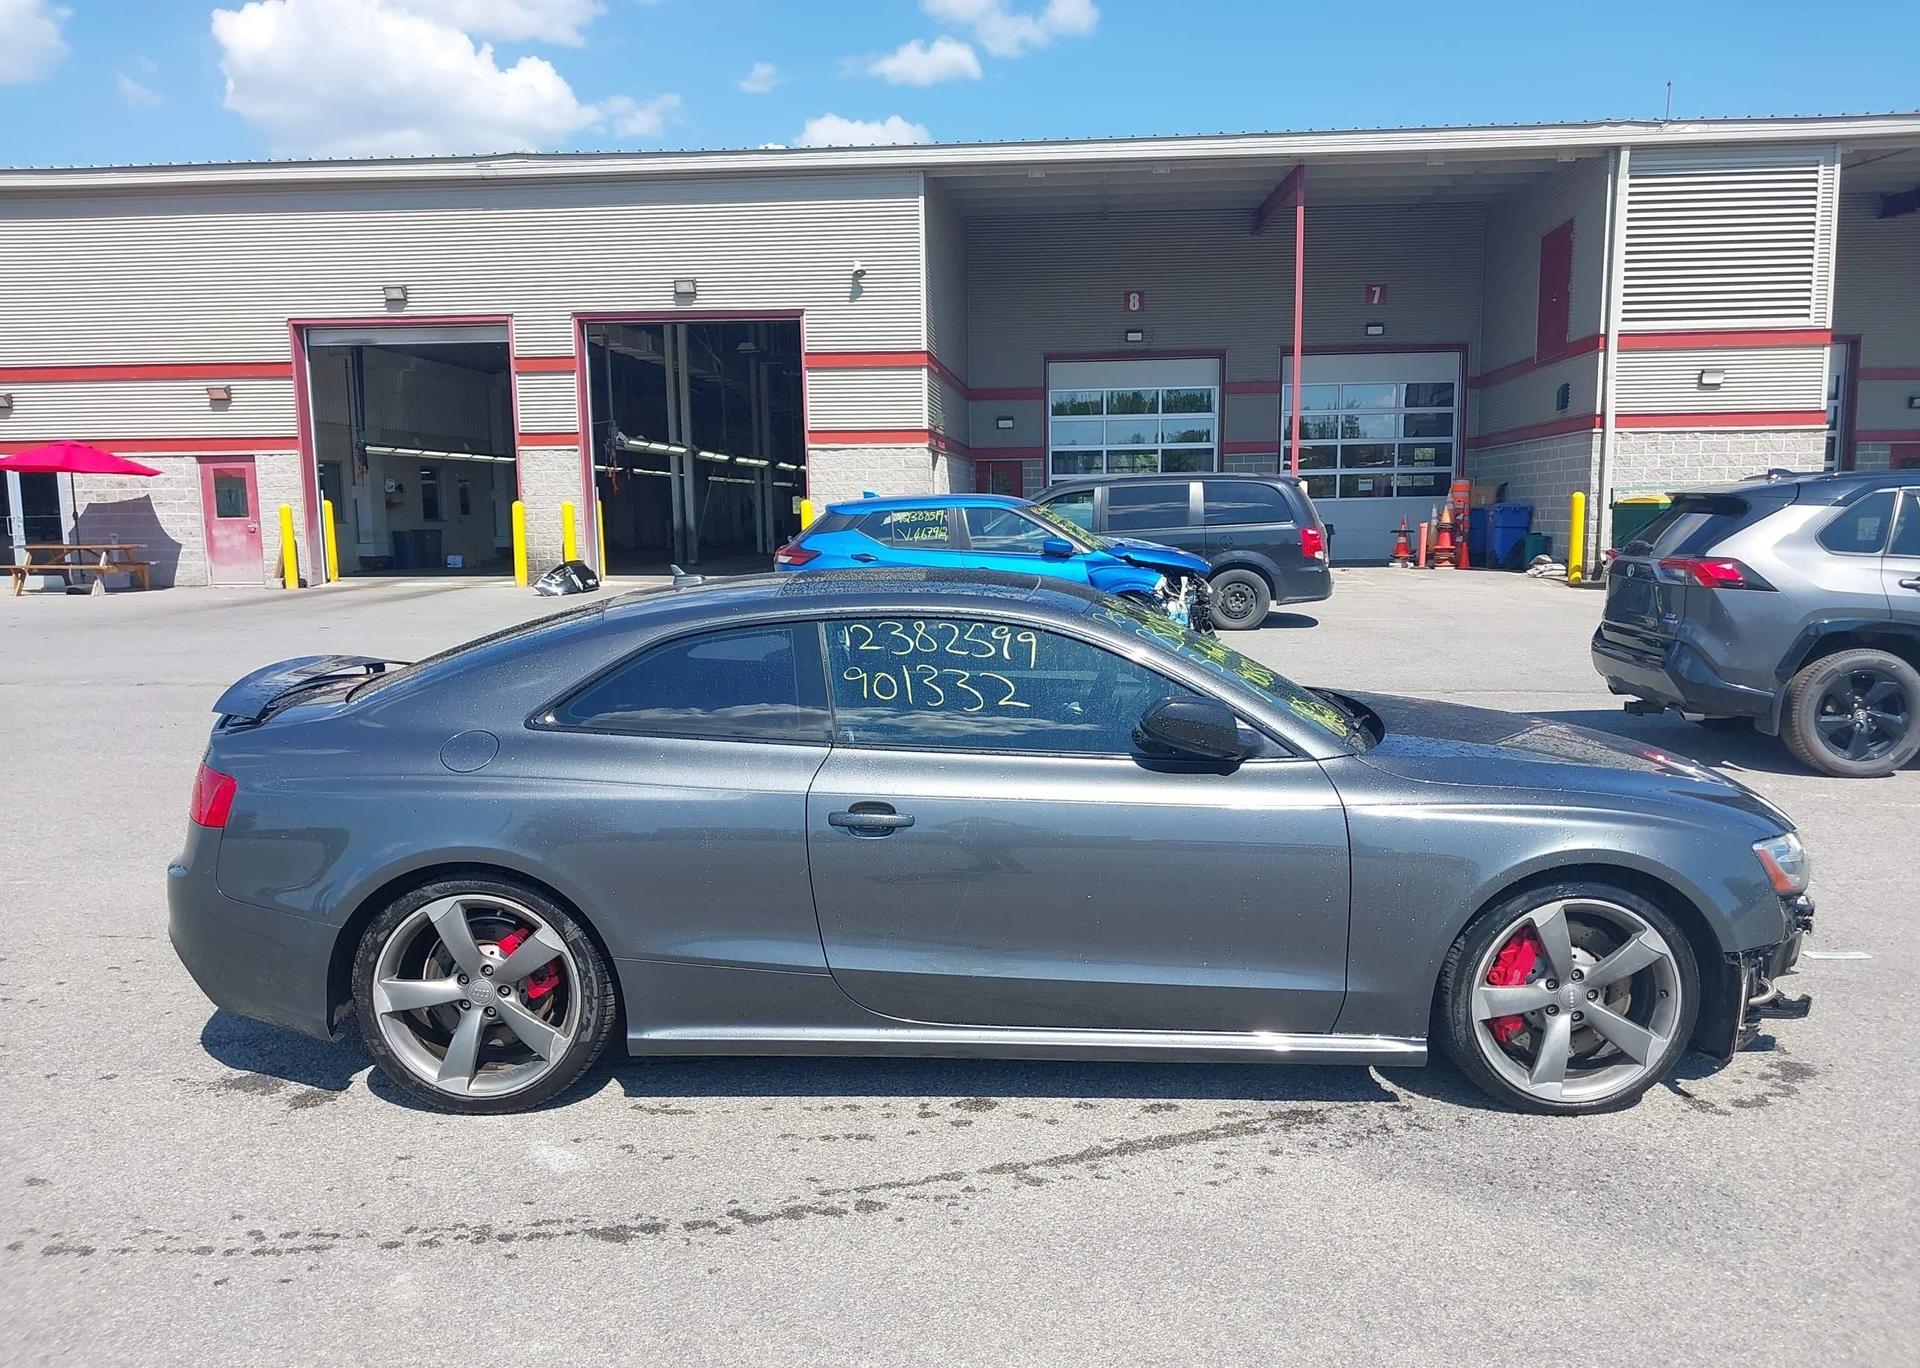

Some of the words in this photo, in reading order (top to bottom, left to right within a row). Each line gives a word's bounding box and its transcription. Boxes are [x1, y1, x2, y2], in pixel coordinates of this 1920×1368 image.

[1129, 293, 1140, 311] 8
[1371, 286, 1381, 304] 7
[844, 621, 1037, 668] 12382599
[844, 665, 1031, 712] 901332
